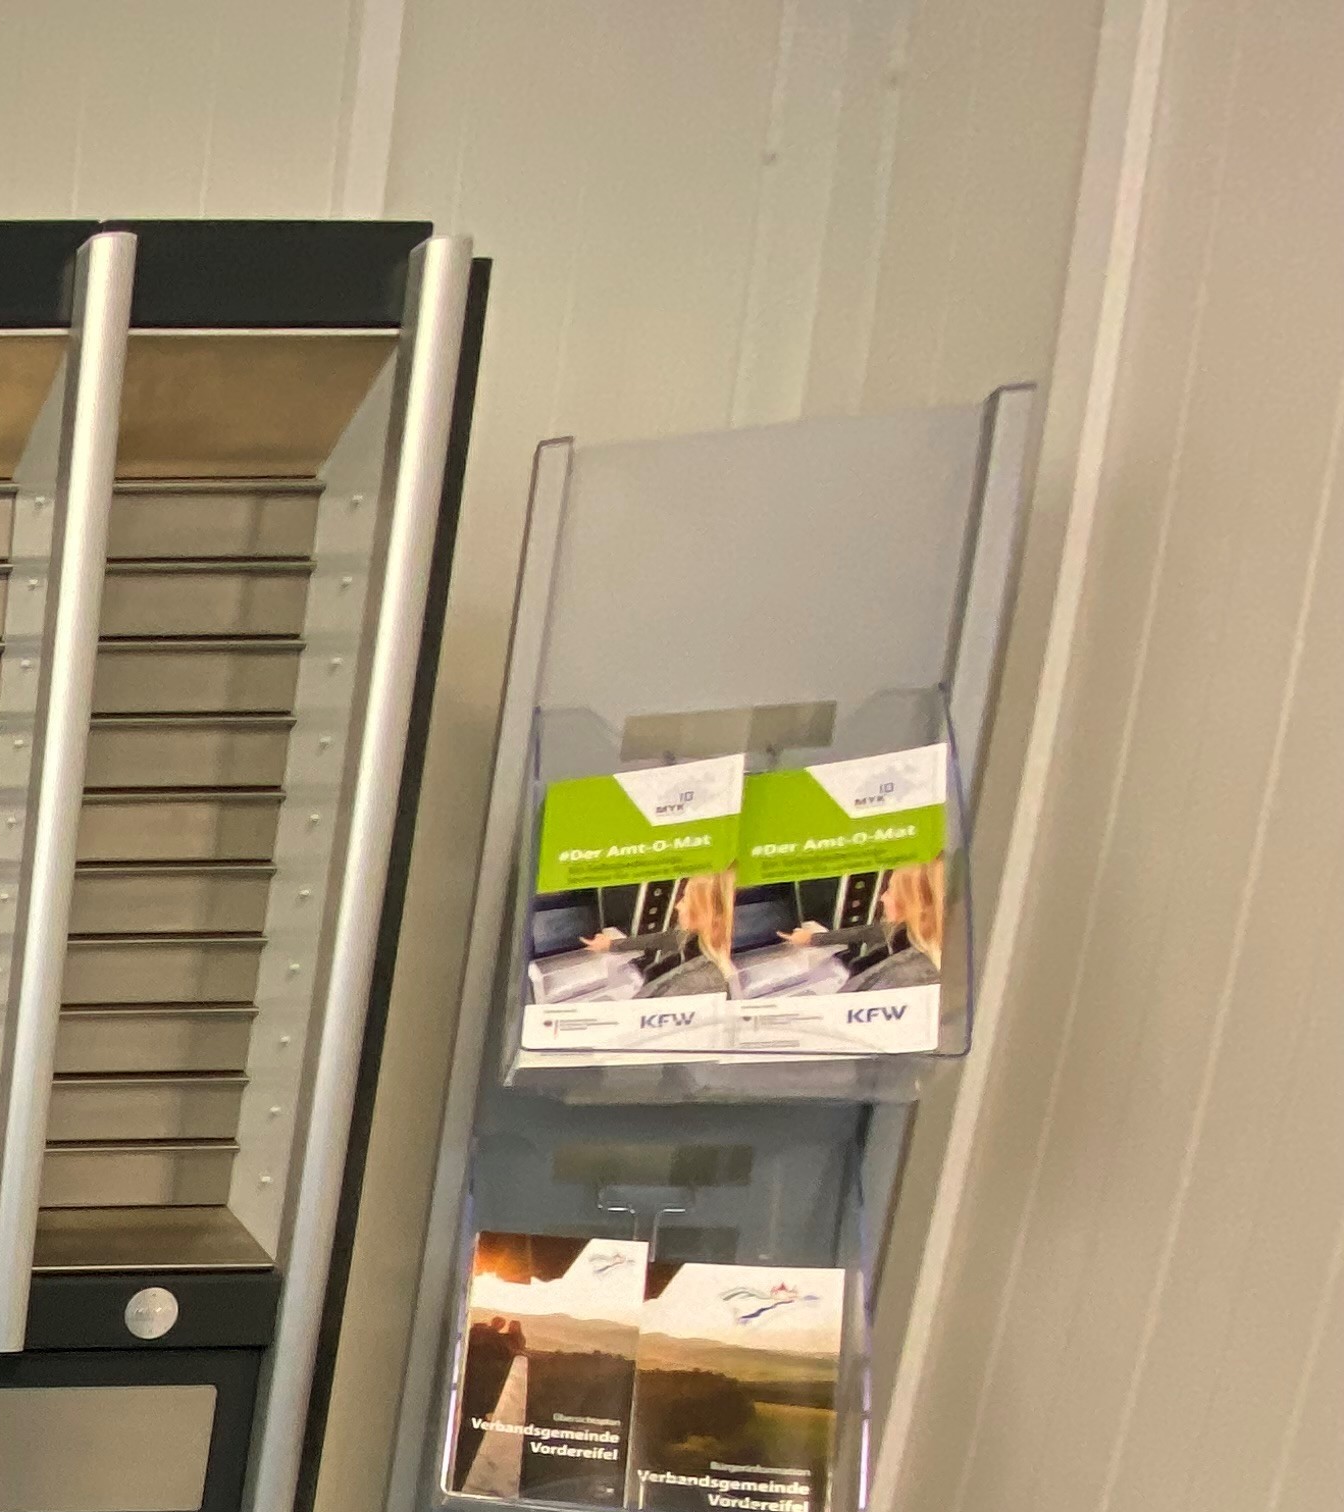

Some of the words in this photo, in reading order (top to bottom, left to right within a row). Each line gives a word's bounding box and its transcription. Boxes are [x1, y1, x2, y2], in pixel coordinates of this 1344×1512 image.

[606, 833, 712, 858] Amt-O-Mat
[803, 824, 917, 851] Amt-O-Mat
[639, 1011, 696, 1029] KFW
[846, 1004, 908, 1024] KFW
[470, 1416, 621, 1445] Verbandsgemeinde
[530, 1441, 618, 1461] Vordereifel
[637, 1469, 810, 1496] Verbandsgemeinde
